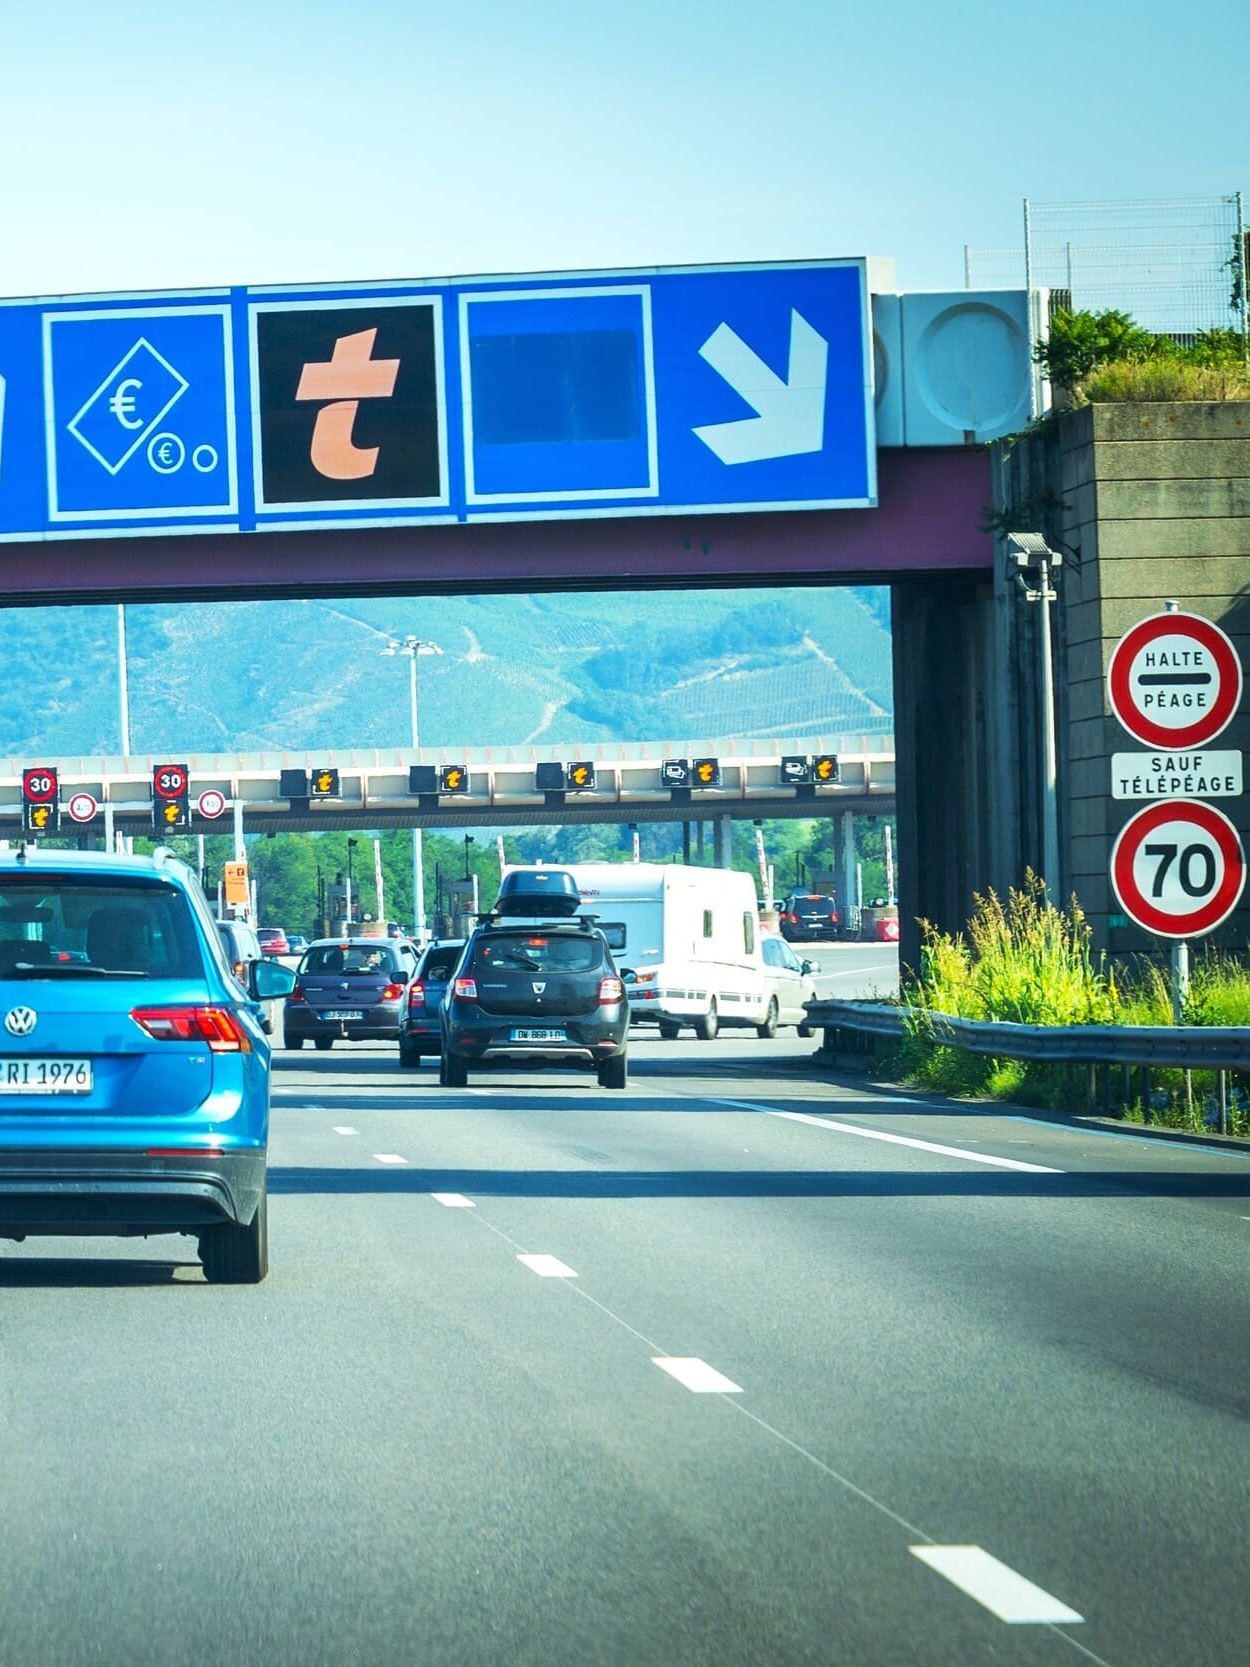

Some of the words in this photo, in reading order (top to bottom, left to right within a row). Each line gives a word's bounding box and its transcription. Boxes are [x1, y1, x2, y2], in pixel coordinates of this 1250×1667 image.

[1145, 651, 1205, 668] HALTE
[1144, 692, 1207, 708] PÉAGE
[1151, 756, 1203, 773] SAUF
[30, 777, 51, 792] 30
[160, 774, 182, 788] 30
[1120, 775, 1236, 795] TÉLÉPÉAGE
[1144, 843, 1217, 898] 70
[7, 1063, 30, 1084] RI
[37, 1063, 87, 1085] 1976
